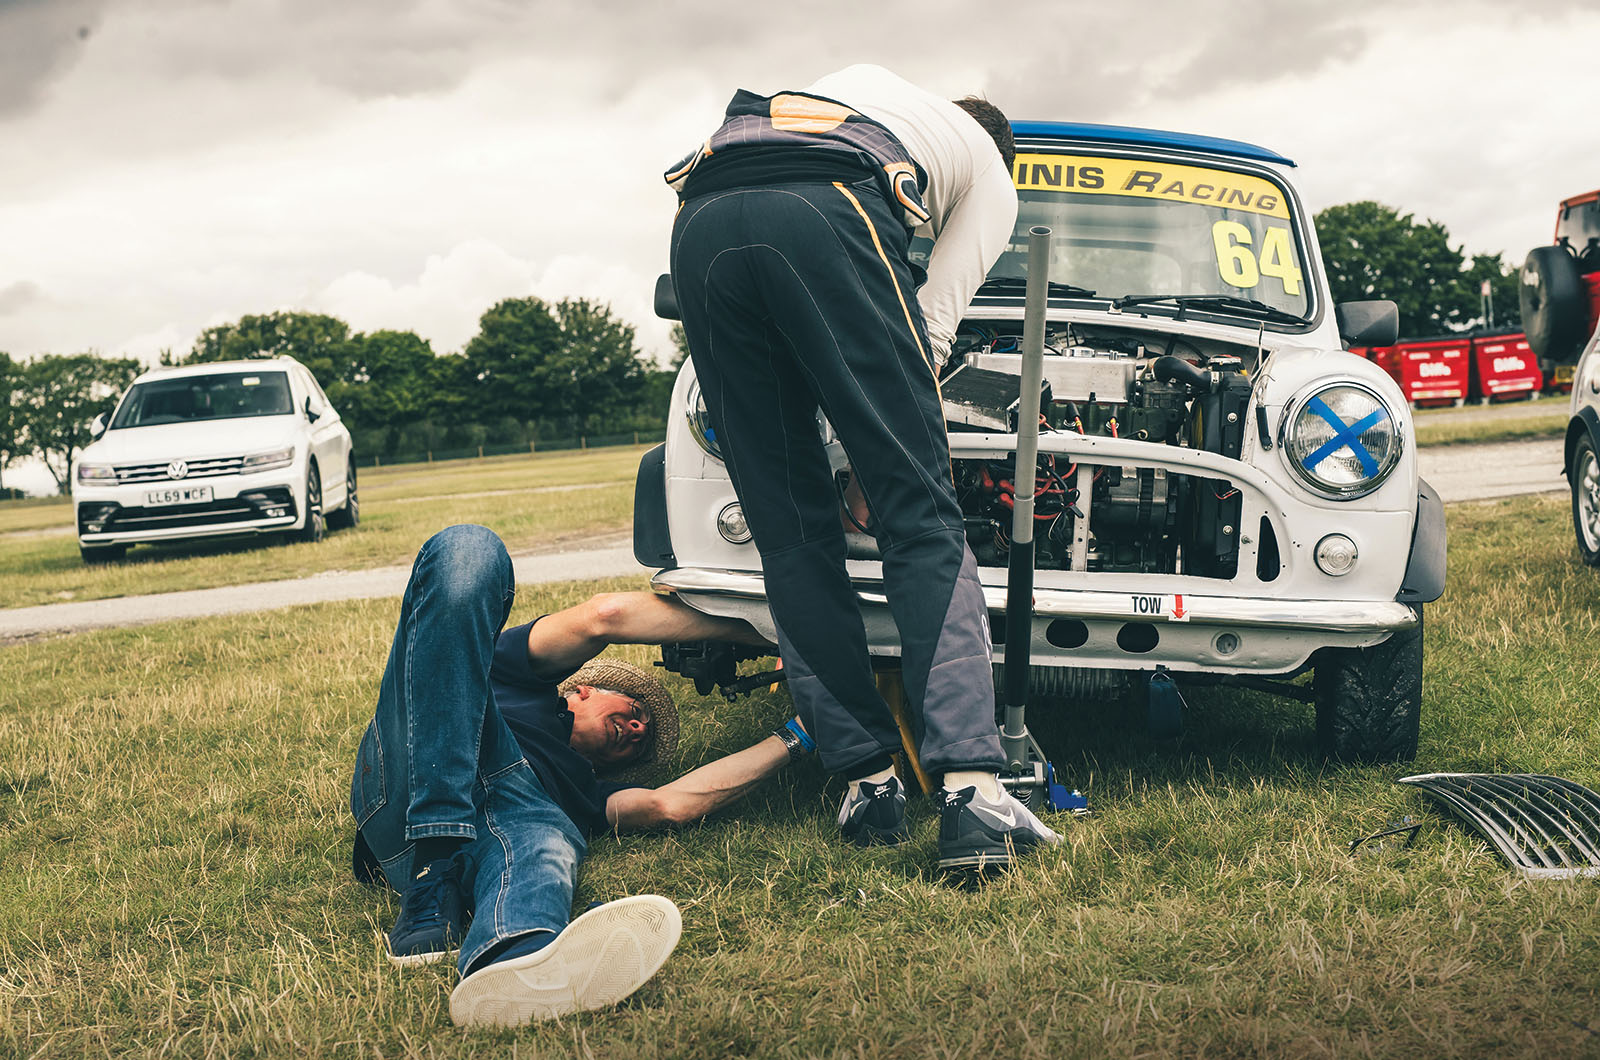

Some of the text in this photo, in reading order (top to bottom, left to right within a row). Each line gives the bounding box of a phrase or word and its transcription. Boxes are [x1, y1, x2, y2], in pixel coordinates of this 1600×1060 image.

[1017, 163, 1105, 189] INIS
[1212, 220, 1302, 296] 64
[148, 488, 207, 504] LL69 WCF
[1131, 596, 1162, 614] TOW
